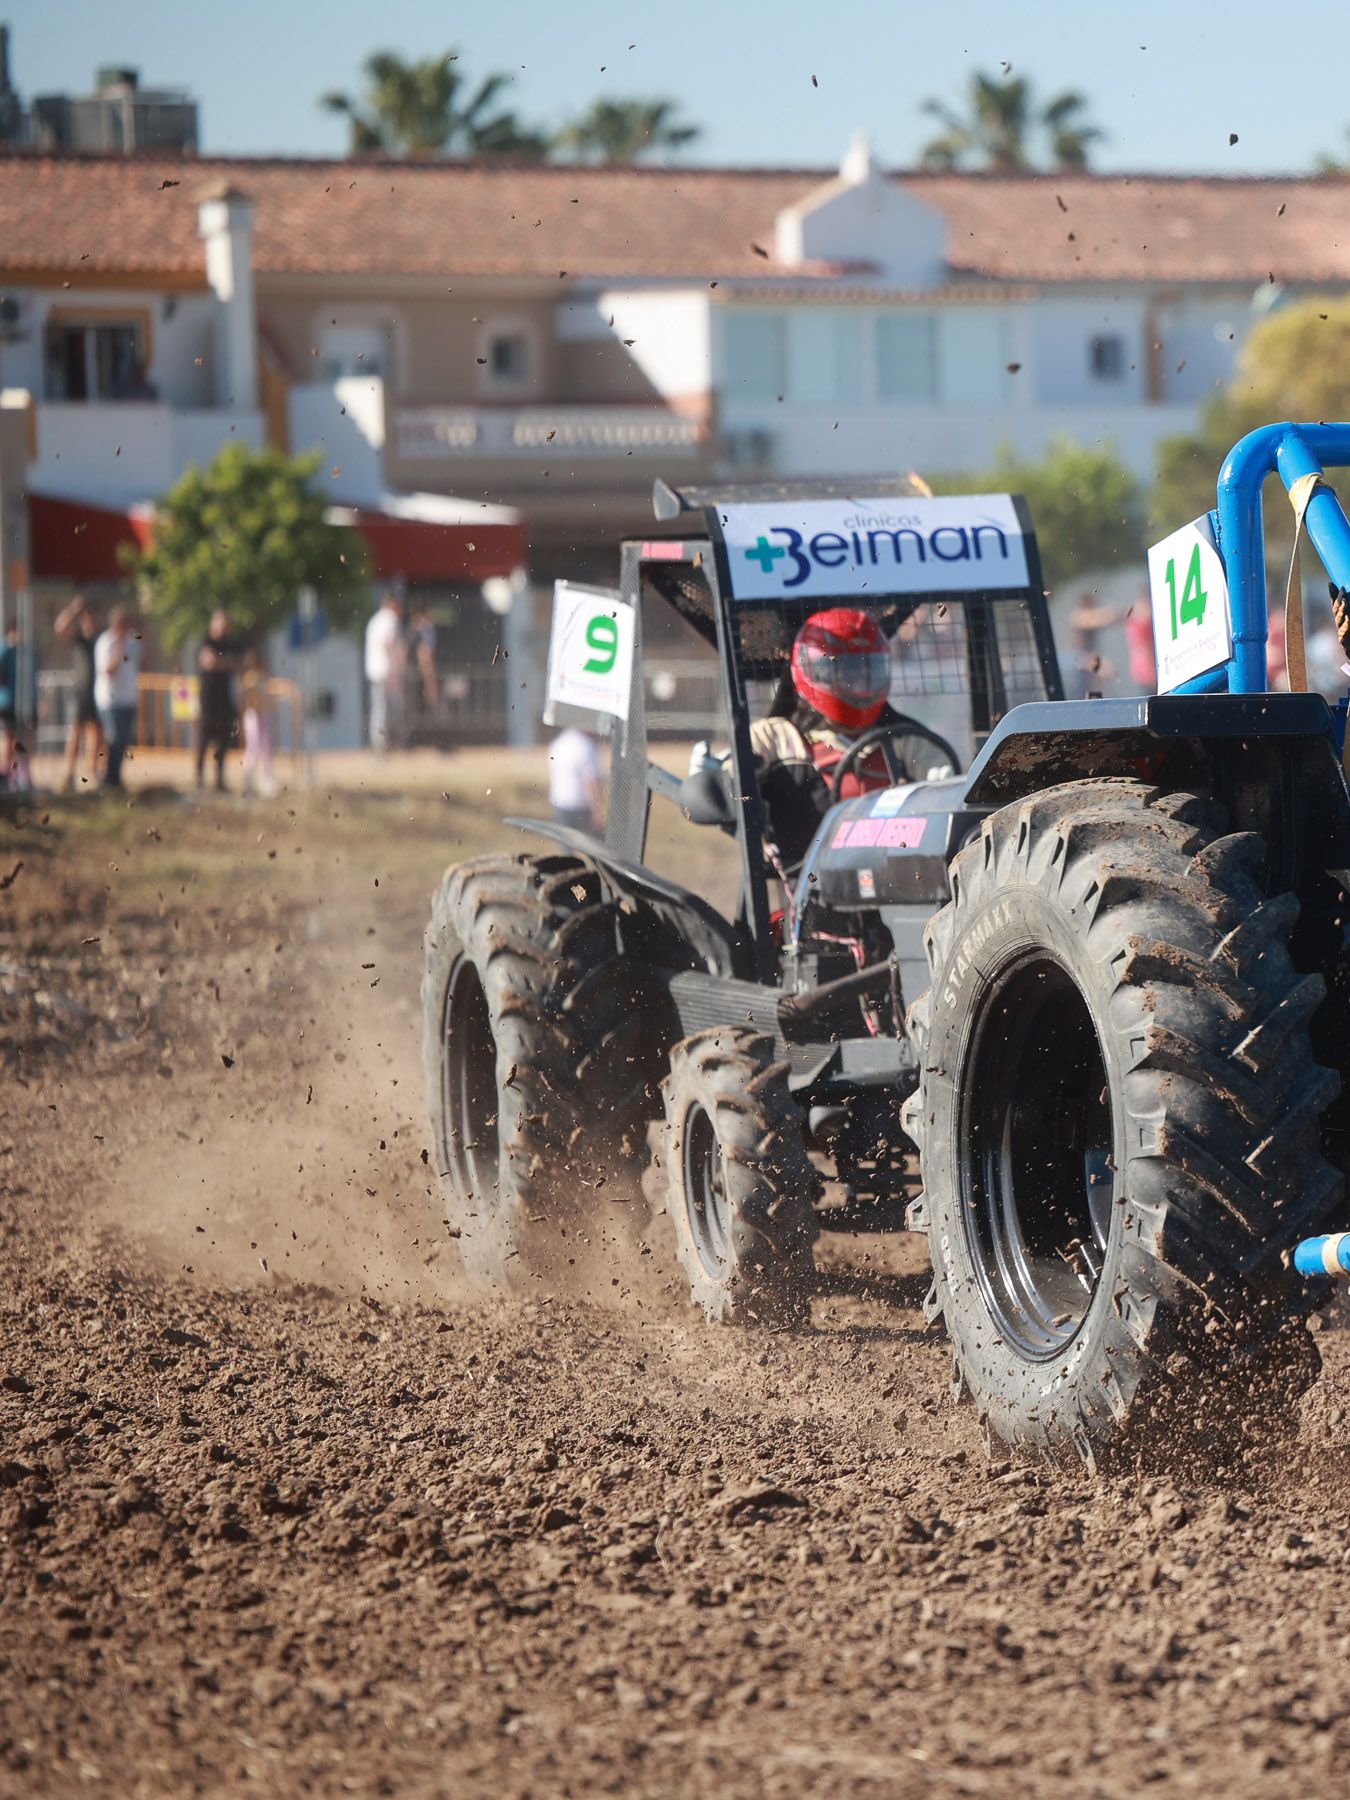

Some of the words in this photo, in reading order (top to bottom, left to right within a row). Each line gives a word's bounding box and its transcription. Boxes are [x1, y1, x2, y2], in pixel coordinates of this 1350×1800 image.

[769, 524, 1009, 588] Beiman
[1165, 542, 1208, 641] 14
[582, 614, 619, 674] 9
[943, 901, 1013, 1009] STARMAXX
